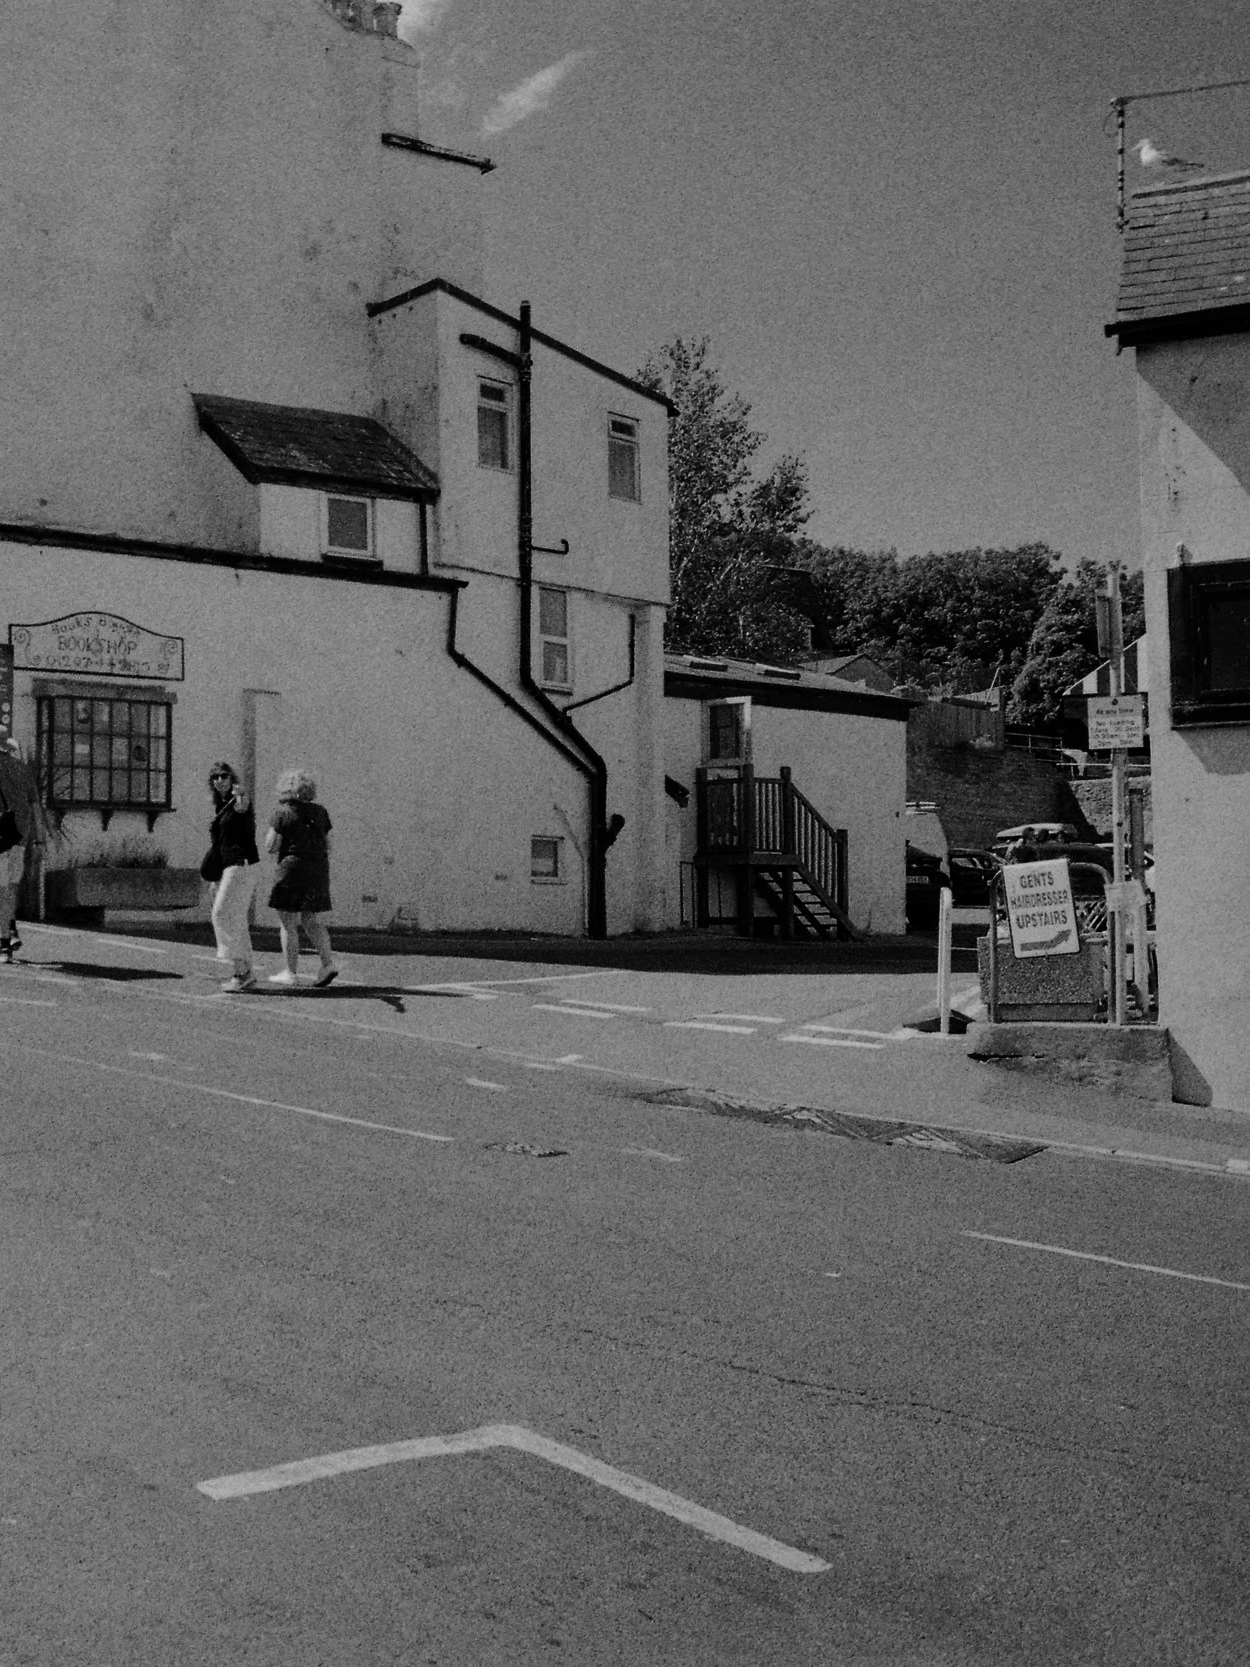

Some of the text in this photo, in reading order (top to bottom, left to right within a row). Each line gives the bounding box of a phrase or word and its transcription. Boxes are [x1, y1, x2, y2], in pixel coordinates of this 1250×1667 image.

[1020, 872, 1054, 889] GENTS
[1010, 890, 1068, 909] HAIRDRESSER
[1016, 910, 1068, 929] UPSTAIRS
